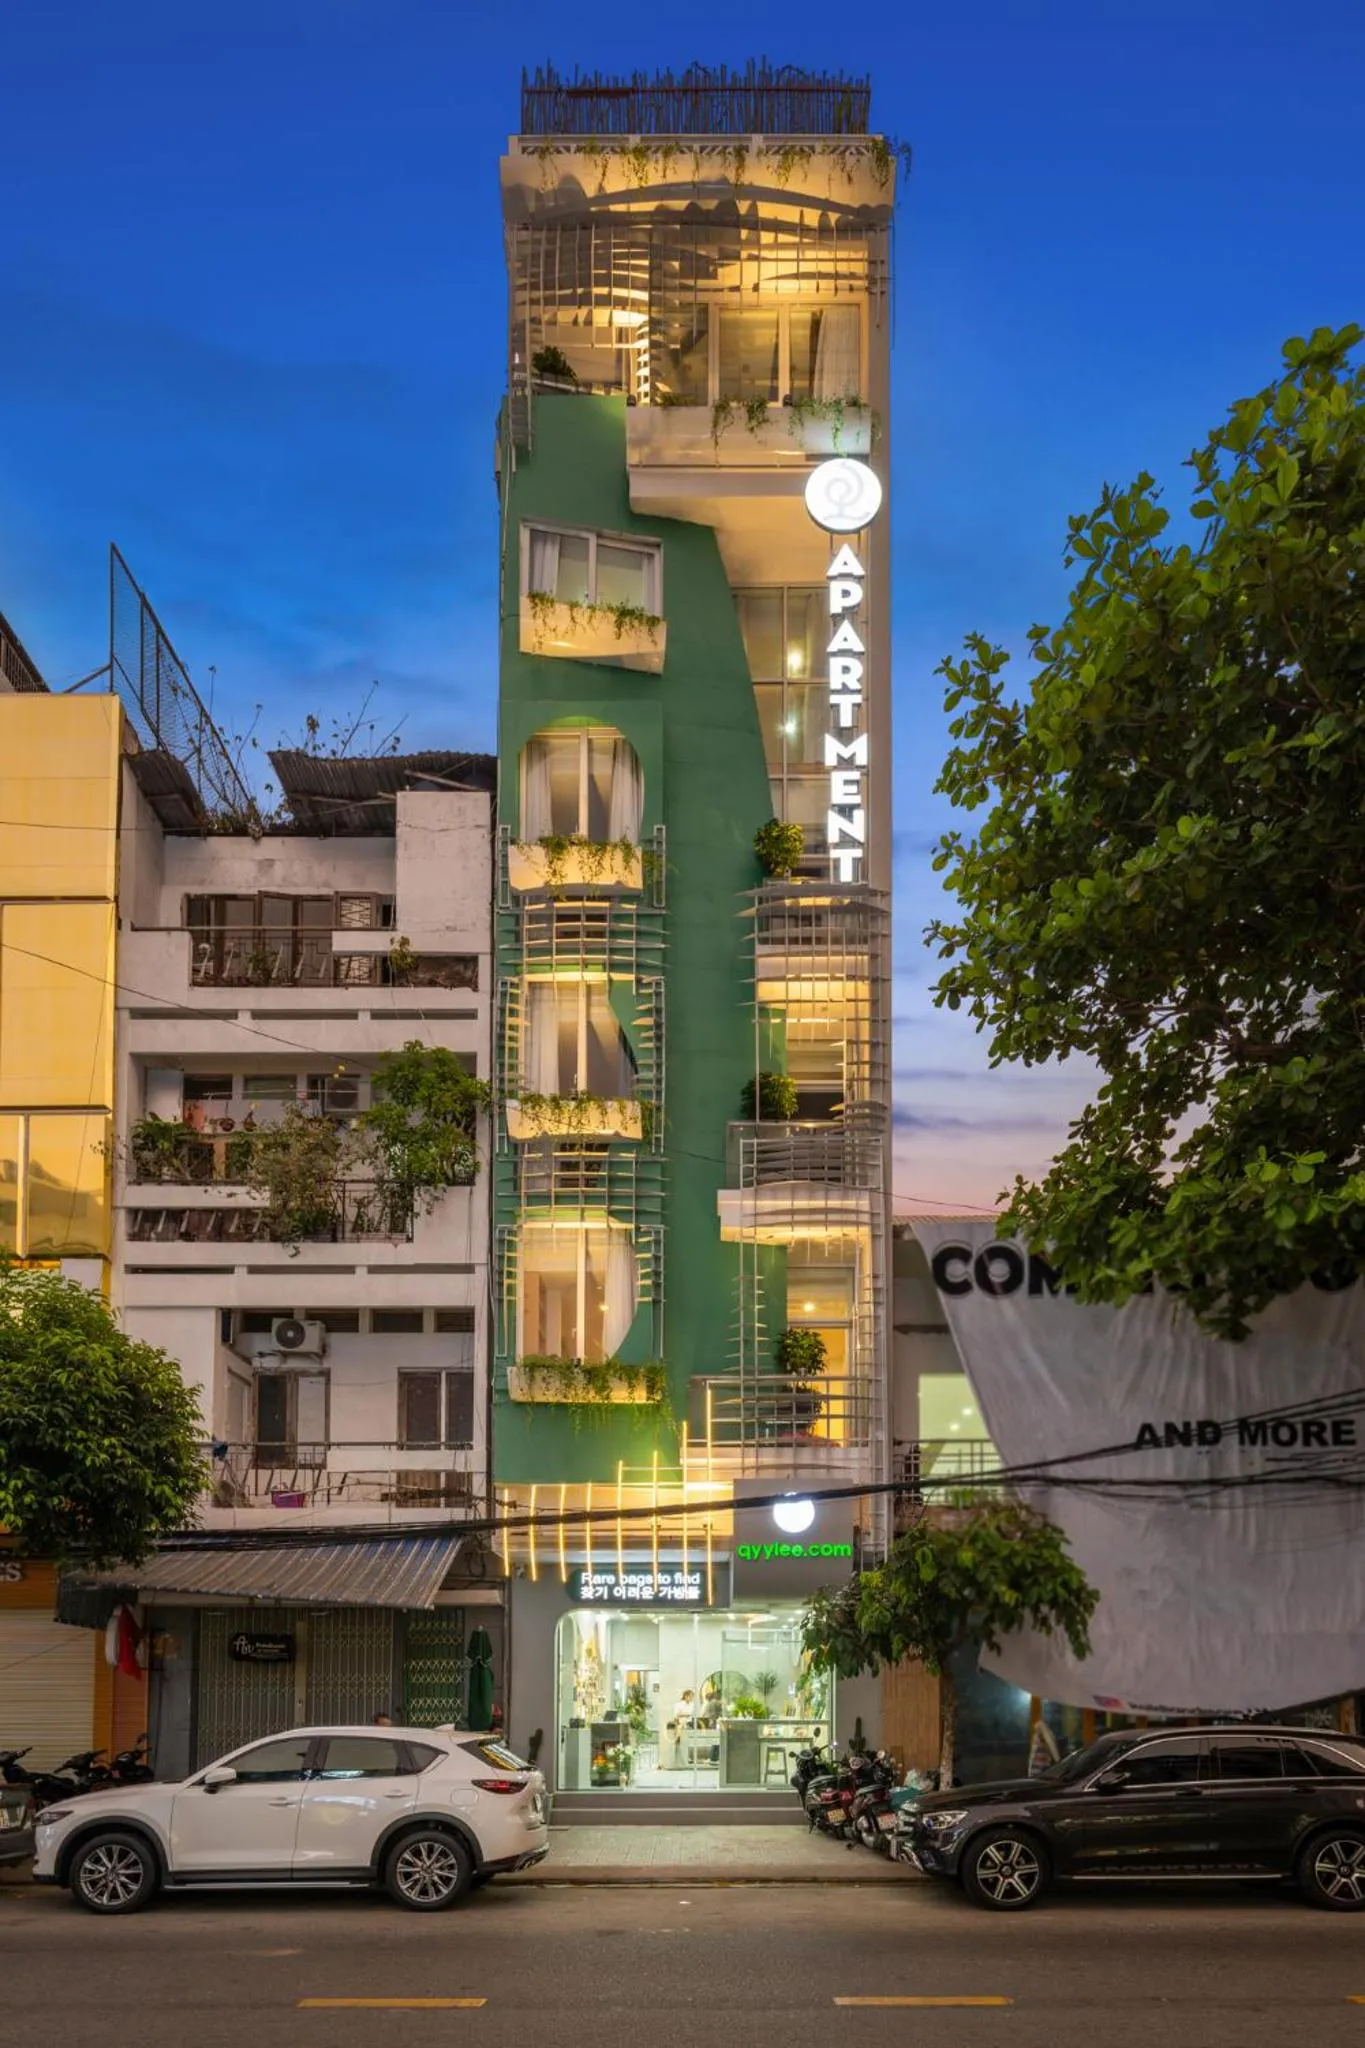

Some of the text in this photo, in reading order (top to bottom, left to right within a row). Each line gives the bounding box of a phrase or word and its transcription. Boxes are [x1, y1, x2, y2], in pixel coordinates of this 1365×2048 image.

[825, 543, 867, 883] APARTMENT
[1136, 1419, 1356, 1448] AND MORE
[738, 1541, 852, 1561] qyylee.com
[581, 1571, 700, 1586] Rare bags to find
[581, 1586, 700, 1599] 찾기 어려운 가방들
